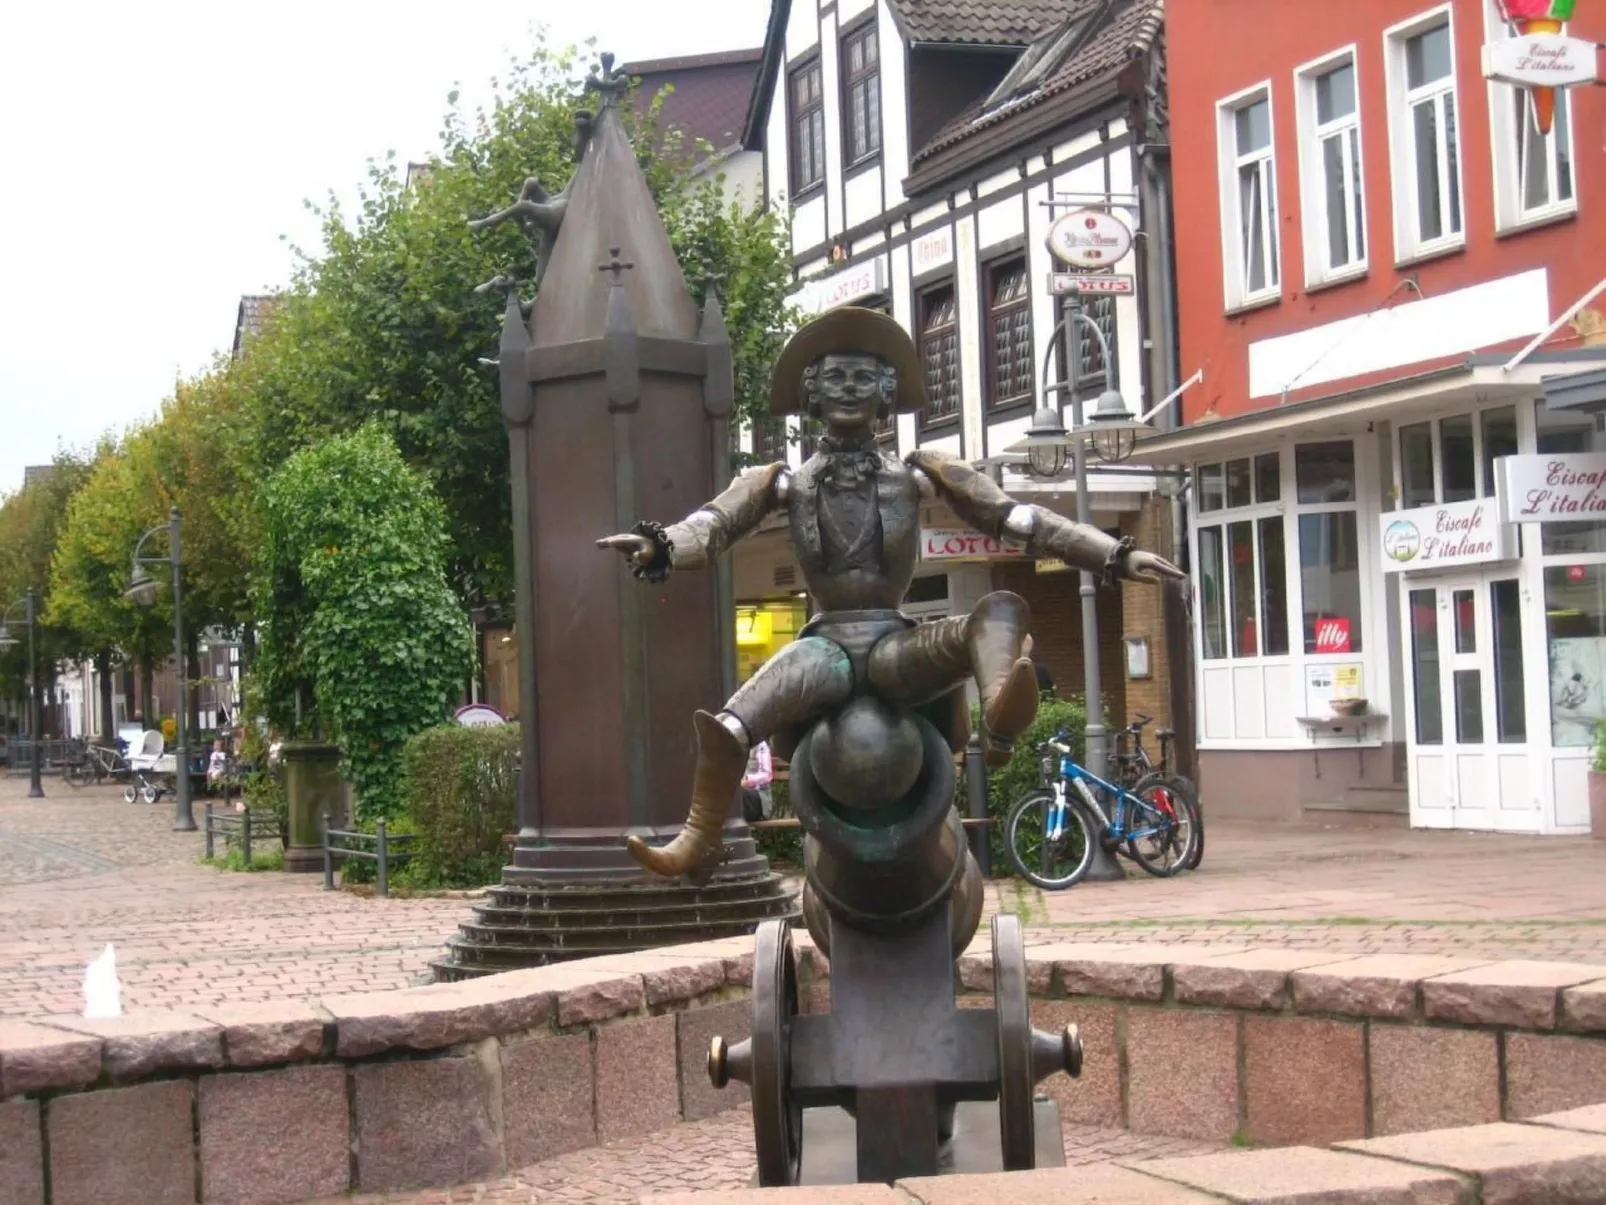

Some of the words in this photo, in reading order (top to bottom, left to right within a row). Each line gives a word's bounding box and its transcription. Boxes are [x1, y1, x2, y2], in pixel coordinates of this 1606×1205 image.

[1436, 505, 1484, 534] Eiscafé
[1421, 535, 1493, 560] L'italiano
[1317, 622, 1348, 650] illy
